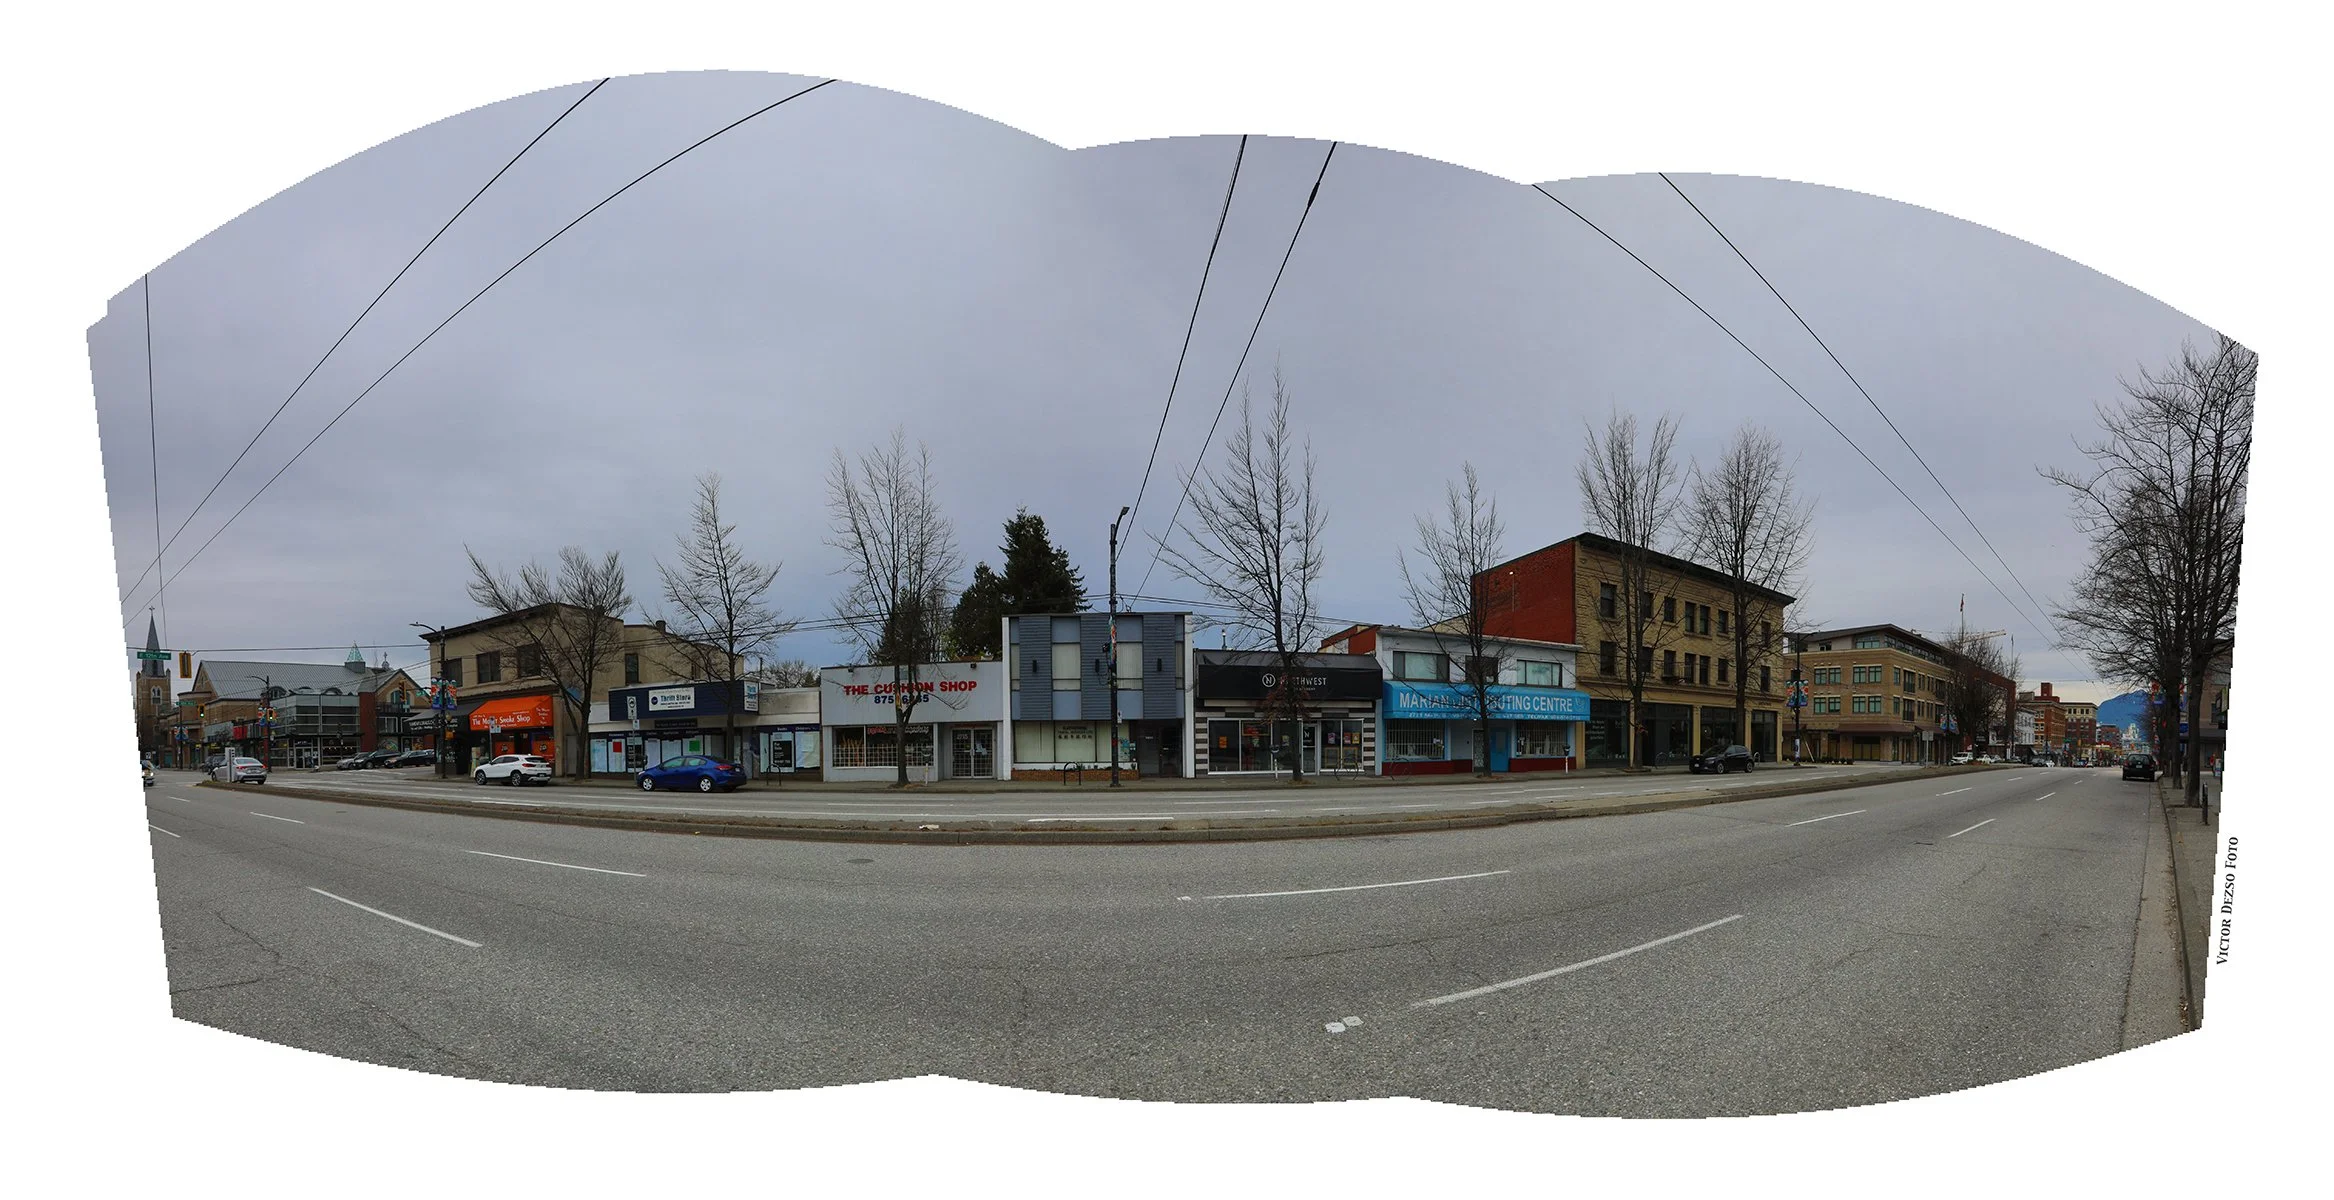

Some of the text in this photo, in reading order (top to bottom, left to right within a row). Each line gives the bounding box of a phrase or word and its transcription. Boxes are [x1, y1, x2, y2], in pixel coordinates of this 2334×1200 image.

[1280, 676, 1327, 686] NTHWEST
[843, 684, 869, 696] THE
[939, 680, 978, 692] SHOP
[1399, 692, 1449, 709] MARIAN
[1532, 696, 1573, 712] CENTRE
[499, 715, 515, 724] Smoke
[516, 714, 531, 724] Shop
